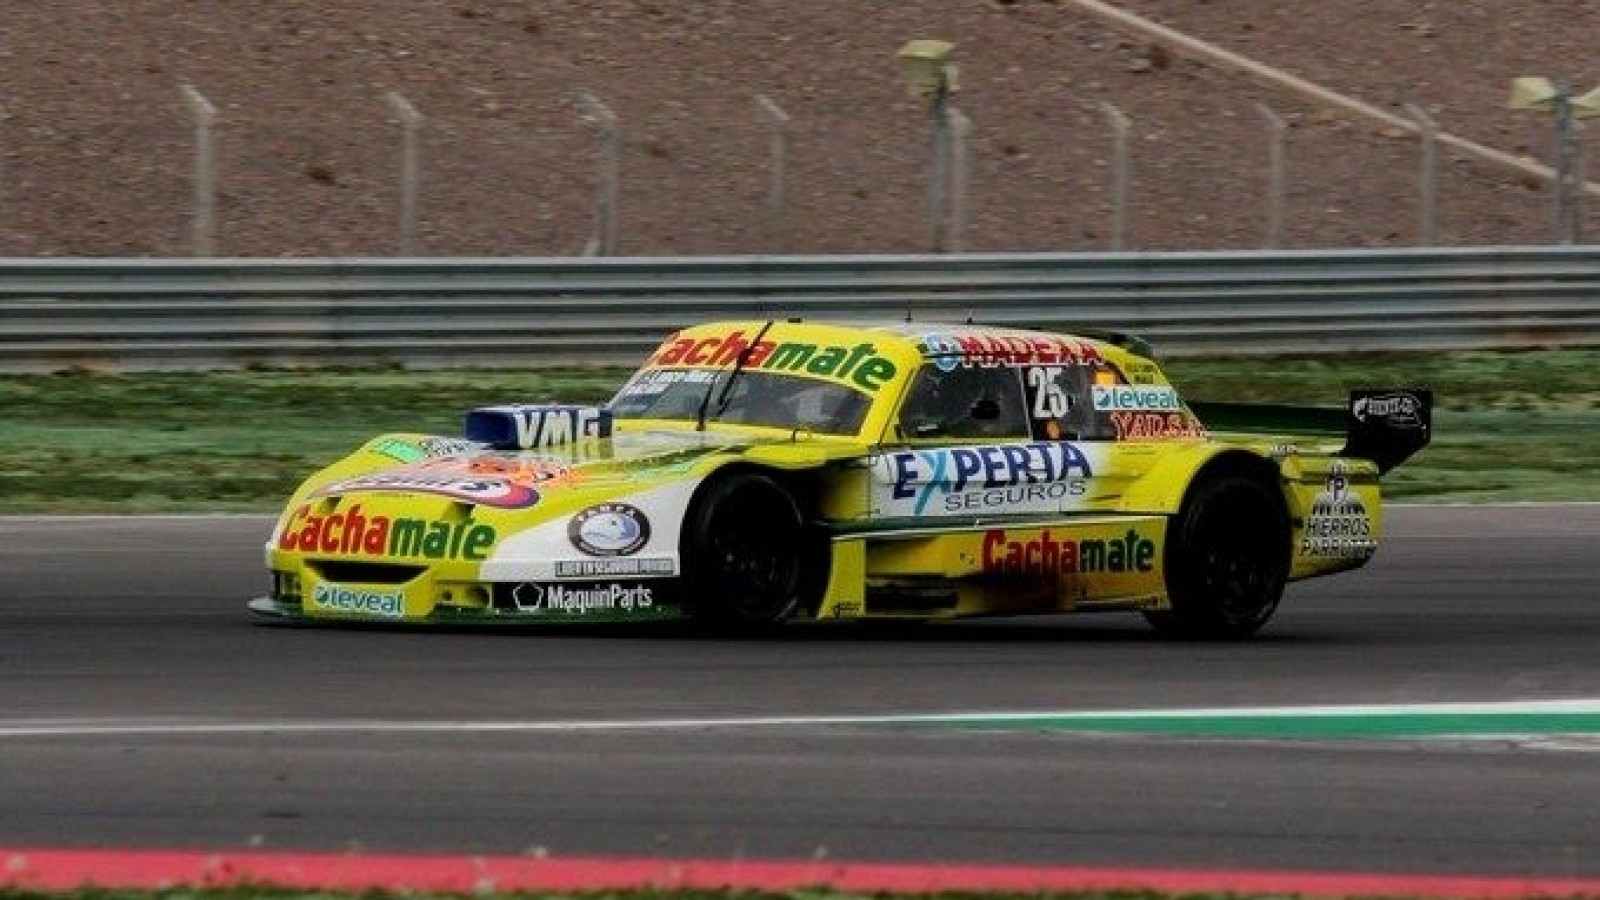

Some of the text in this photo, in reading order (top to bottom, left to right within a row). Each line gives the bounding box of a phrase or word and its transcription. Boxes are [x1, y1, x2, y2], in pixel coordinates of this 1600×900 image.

[1028, 366, 1069, 419] 25
[893, 443, 1092, 515] EXPERTA
[945, 480, 1086, 511] SEGUROS
[280, 503, 496, 560] Cachamate
[980, 529, 1155, 574] Cachamate
[548, 583, 653, 614] MaquinParts
